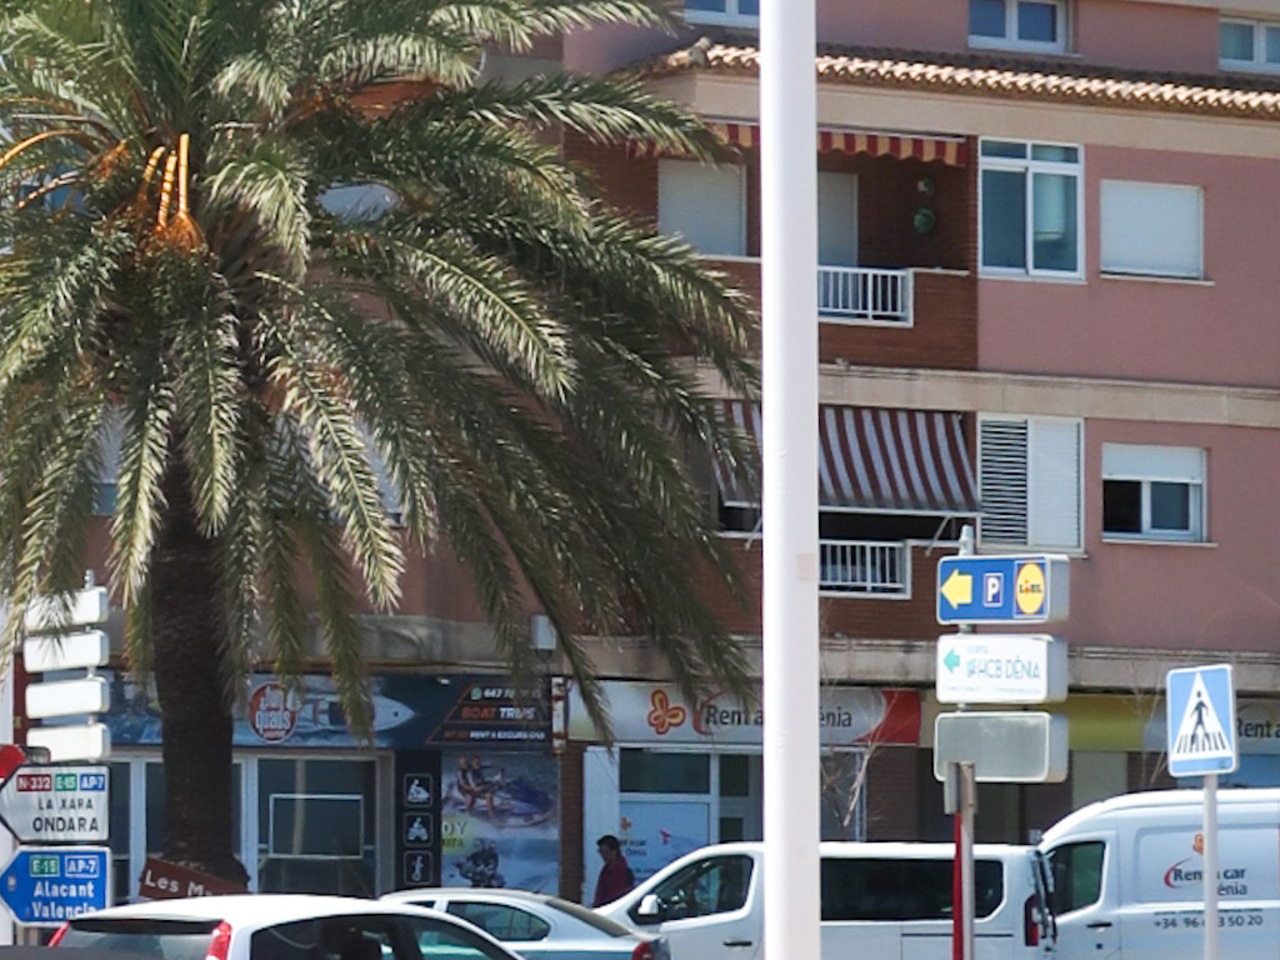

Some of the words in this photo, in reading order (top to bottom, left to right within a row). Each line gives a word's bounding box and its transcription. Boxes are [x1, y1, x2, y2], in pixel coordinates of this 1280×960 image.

[461, 706, 497, 720] BOAT
[705, 704, 750, 726] Rent
[818, 705, 852, 728] énia
[80, 775, 105, 790] AP-7
[38, 800, 53, 811] LA
[61, 799, 94, 811] XARA
[32, 817, 100, 833] ONDARA
[68, 860, 96, 873] AP-7
[145, 869, 180, 893] Les
[1173, 868, 1204, 881] Ren
[1223, 868, 1247, 880] car
[34, 880, 95, 898] Alacant
[1216, 882, 1248, 896] énia
[1154, 917, 1177, 929] +34
[1183, 916, 1200, 928] 96
[1228, 915, 1245, 928] 50
[1247, 914, 1263, 926] 20
